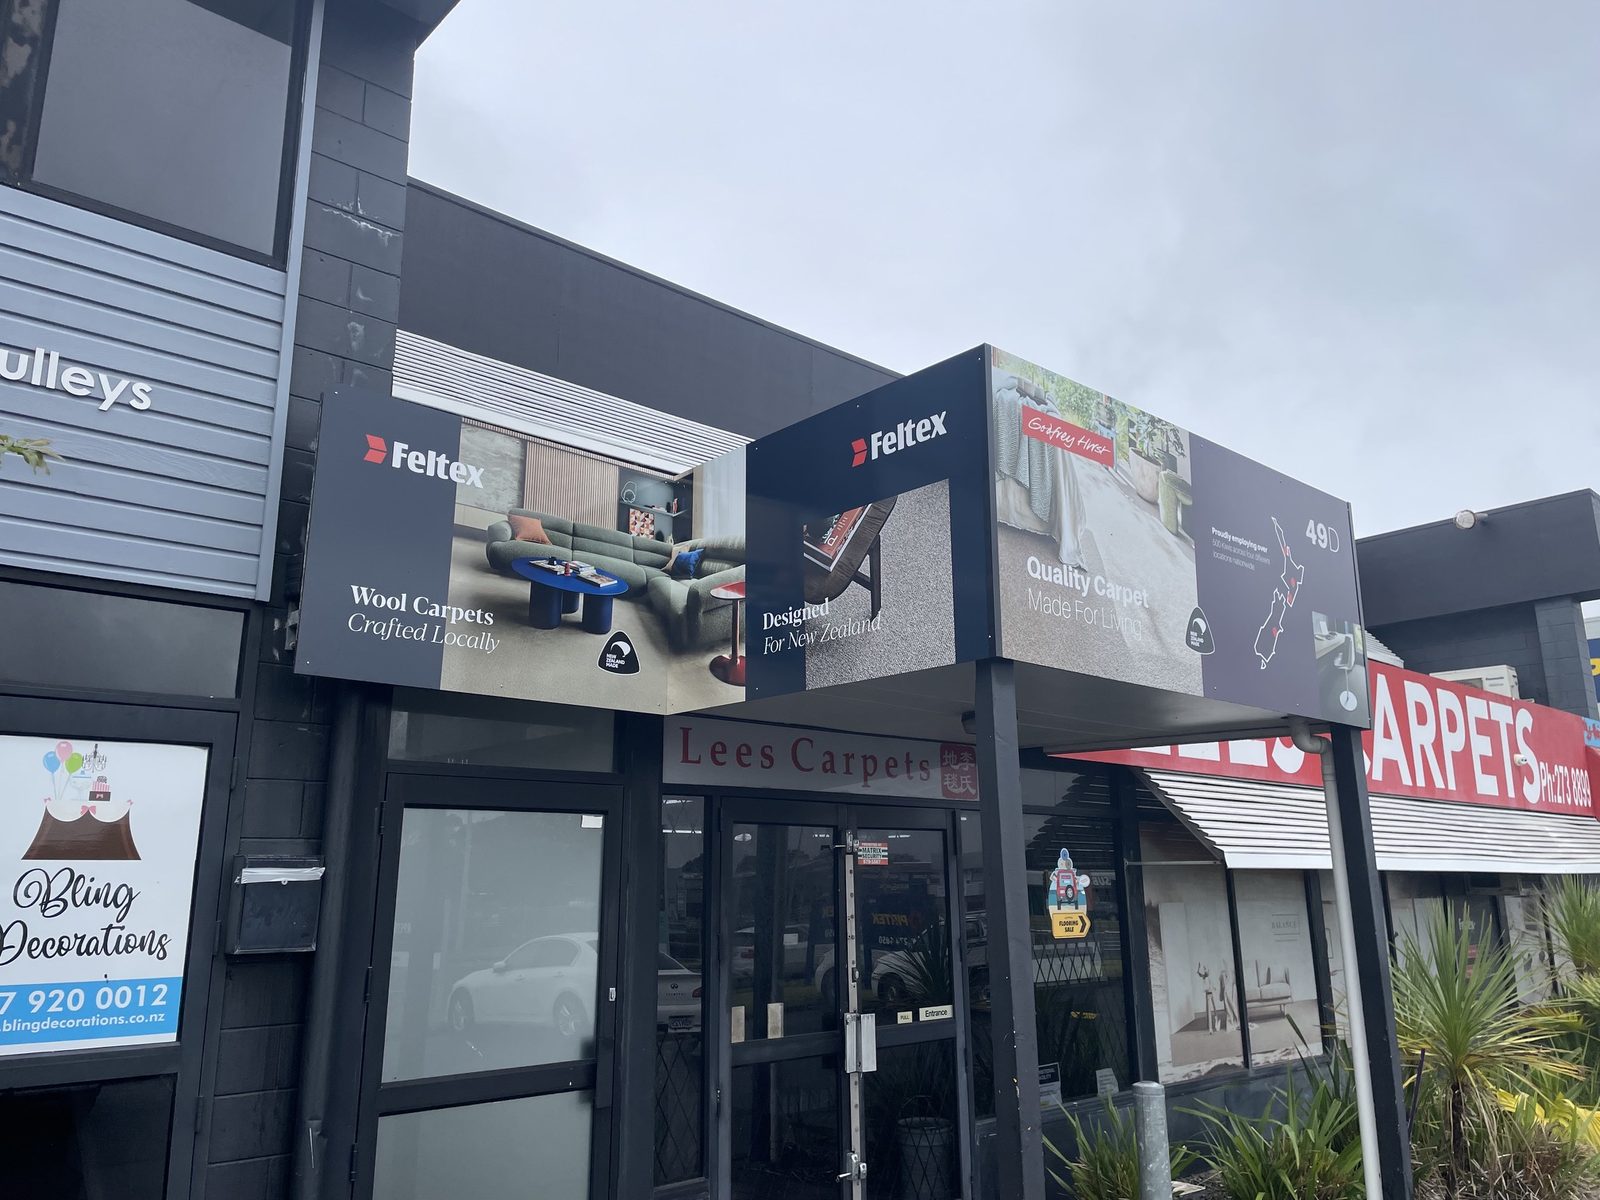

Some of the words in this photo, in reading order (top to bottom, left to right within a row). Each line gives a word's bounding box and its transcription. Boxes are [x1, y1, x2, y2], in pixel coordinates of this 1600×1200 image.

[870, 411, 947, 460] Feltex
[1028, 417, 1076, 448] Godfrey
[1077, 435, 1111, 455] Hirst
[391, 441, 485, 489] Feltex
[1211, 526, 1232, 542] Proudly
[1231, 535, 1258, 552] employing
[1257, 544, 1268, 553] over
[350, 584, 407, 613] Wool
[413, 596, 495, 626] Carpets
[1026, 556, 1091, 597] Quality
[1093, 575, 1149, 609] Carpet
[348, 612, 428, 641] Crafted
[431, 624, 501, 654] Locally
[762, 597, 830, 630] Designed
[763, 636, 786, 655] For
[787, 630, 818, 650] New
[820, 610, 882, 643] Zealand
[1027, 588, 1072, 619] Made
[1075, 600, 1099, 625] For
[1101, 607, 1142, 641] Living
[679, 726, 775, 769] Lees
[791, 737, 931, 788] Carpets
[1363, 673, 1540, 804] ARPETS
[1570, 767, 1592, 808] 8899
[13, 867, 142, 923] Bling
[0, 918, 172, 966] Decorations
[28, 988, 85, 1014] 920
[96, 984, 168, 1010] 0012
[924, 1010, 948, 1018] Entrance
